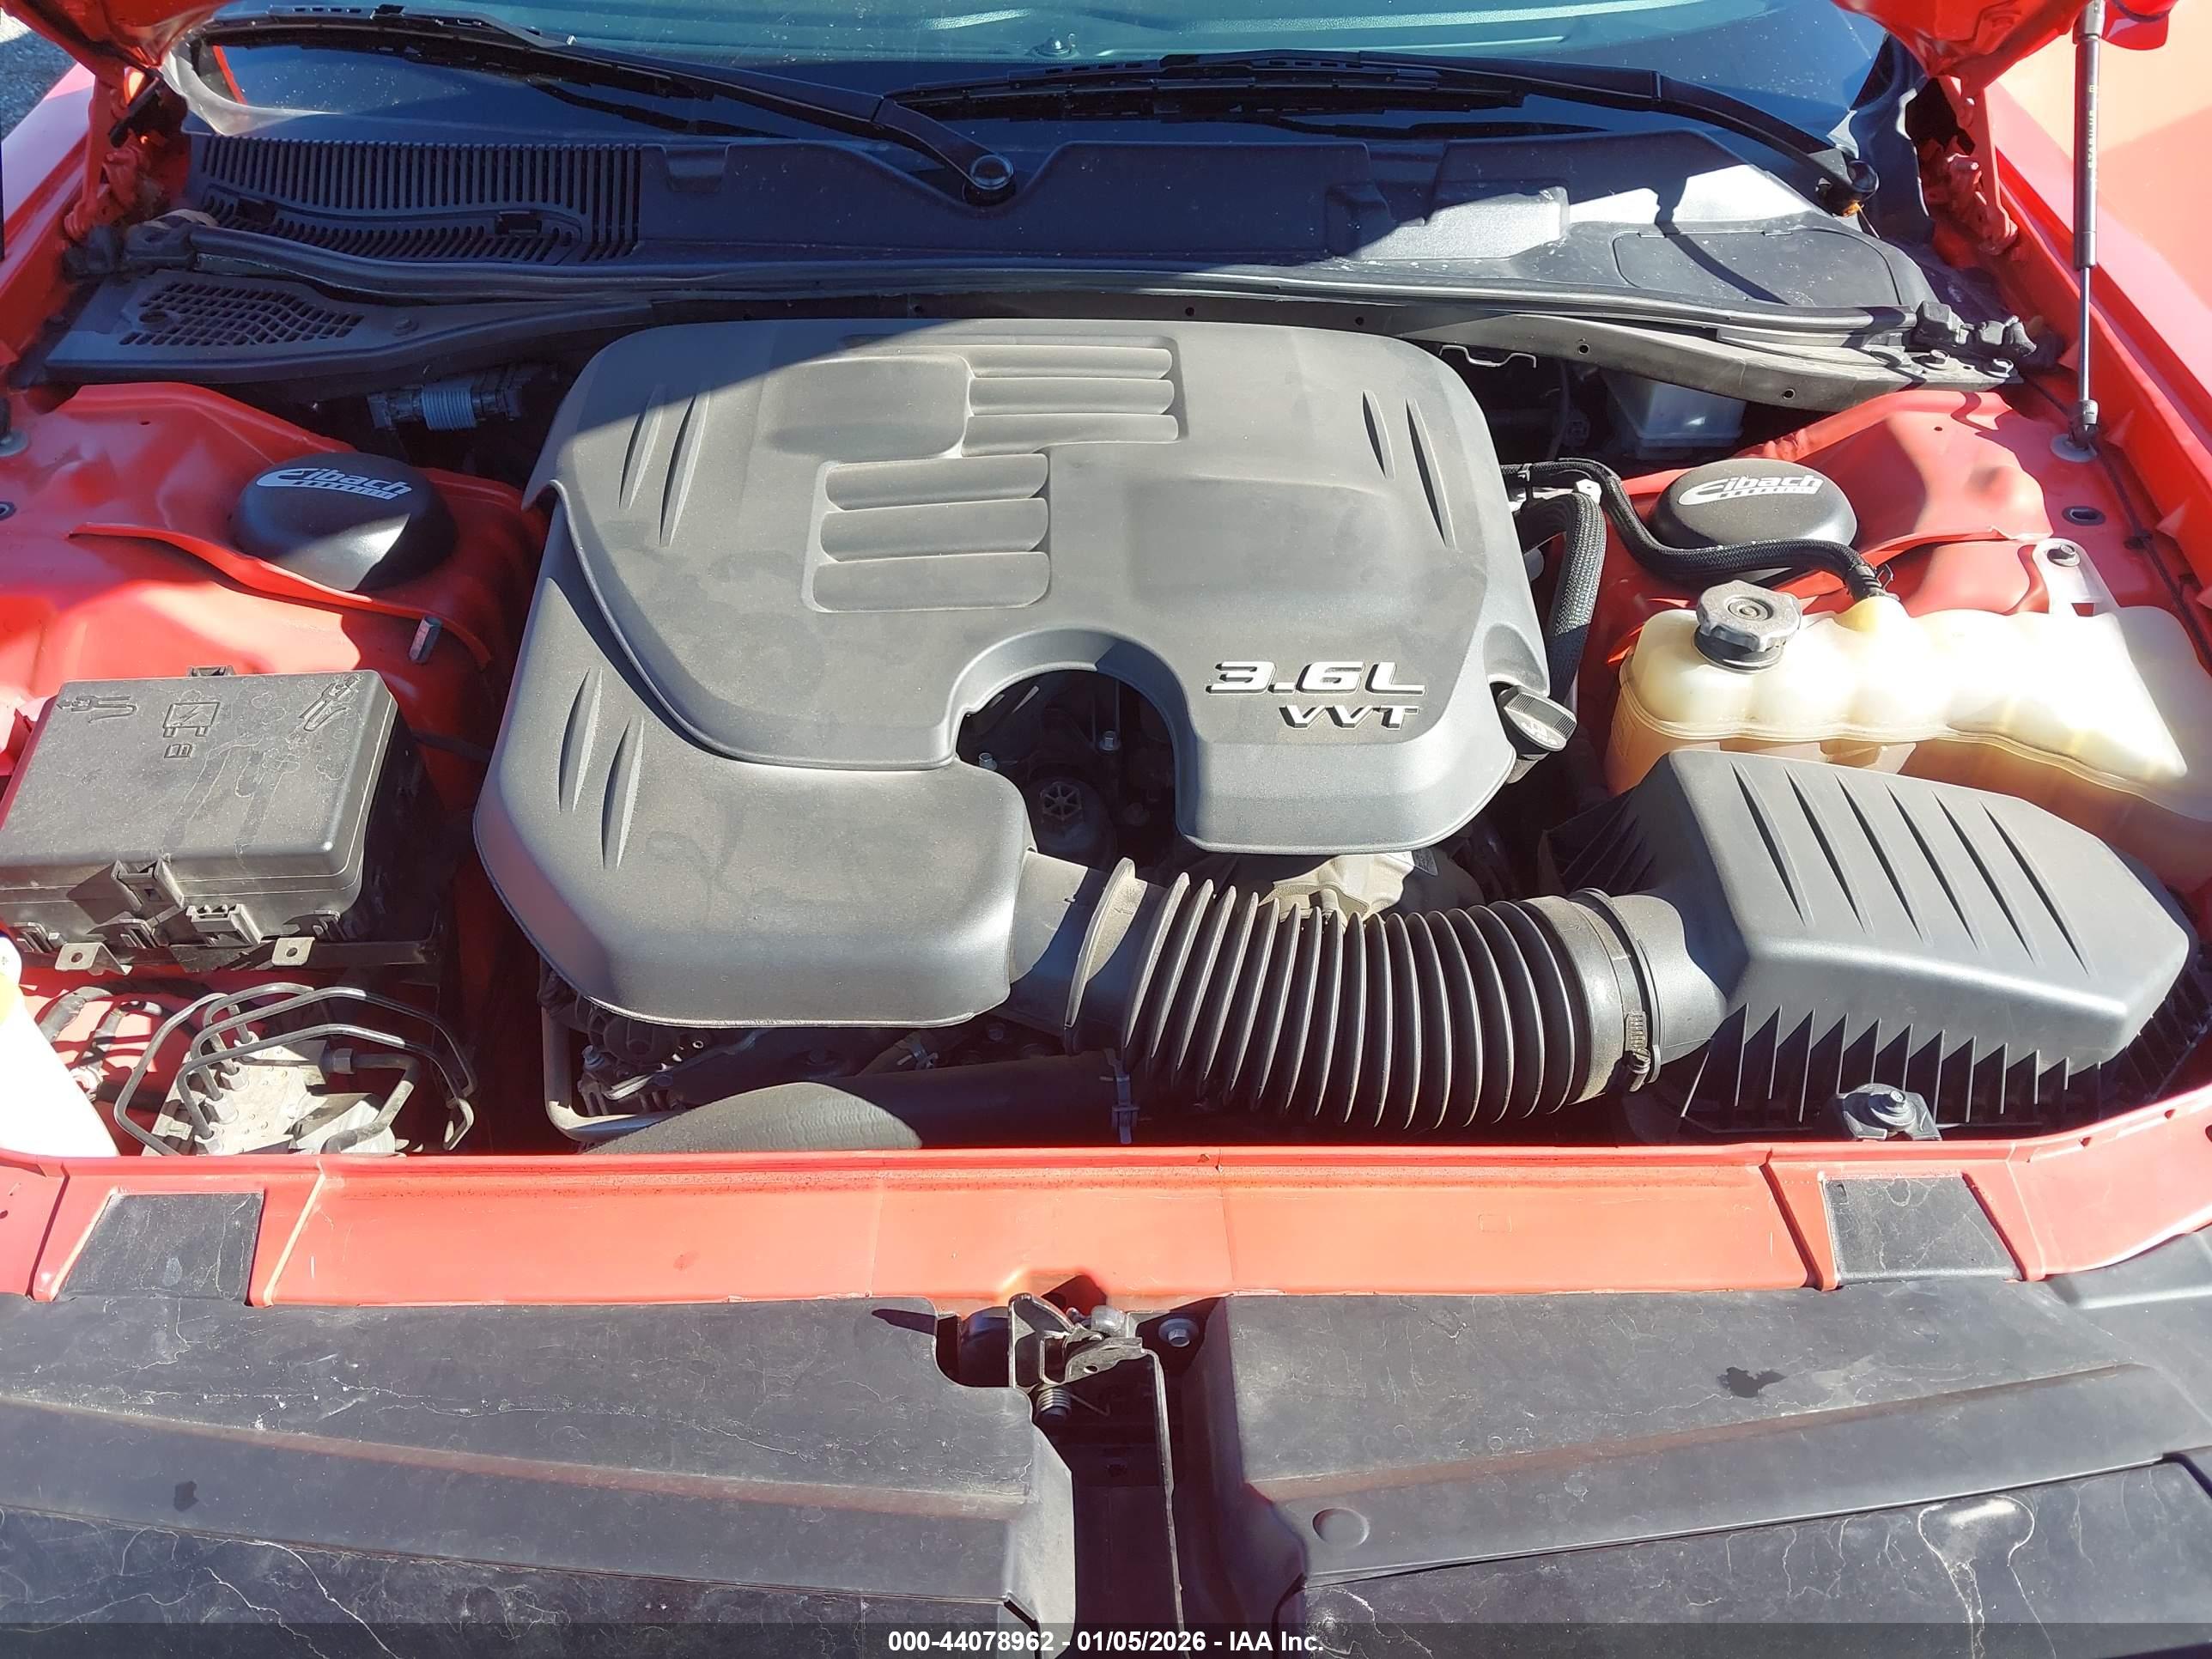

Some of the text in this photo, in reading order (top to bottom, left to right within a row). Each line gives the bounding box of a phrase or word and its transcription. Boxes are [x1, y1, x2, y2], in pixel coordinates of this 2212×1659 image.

[257, 468, 412, 500] Eibach
[1678, 475, 1825, 506] Eibach
[1206, 661, 1425, 695] 3.6L
[1279, 705, 1419, 729] VVT
